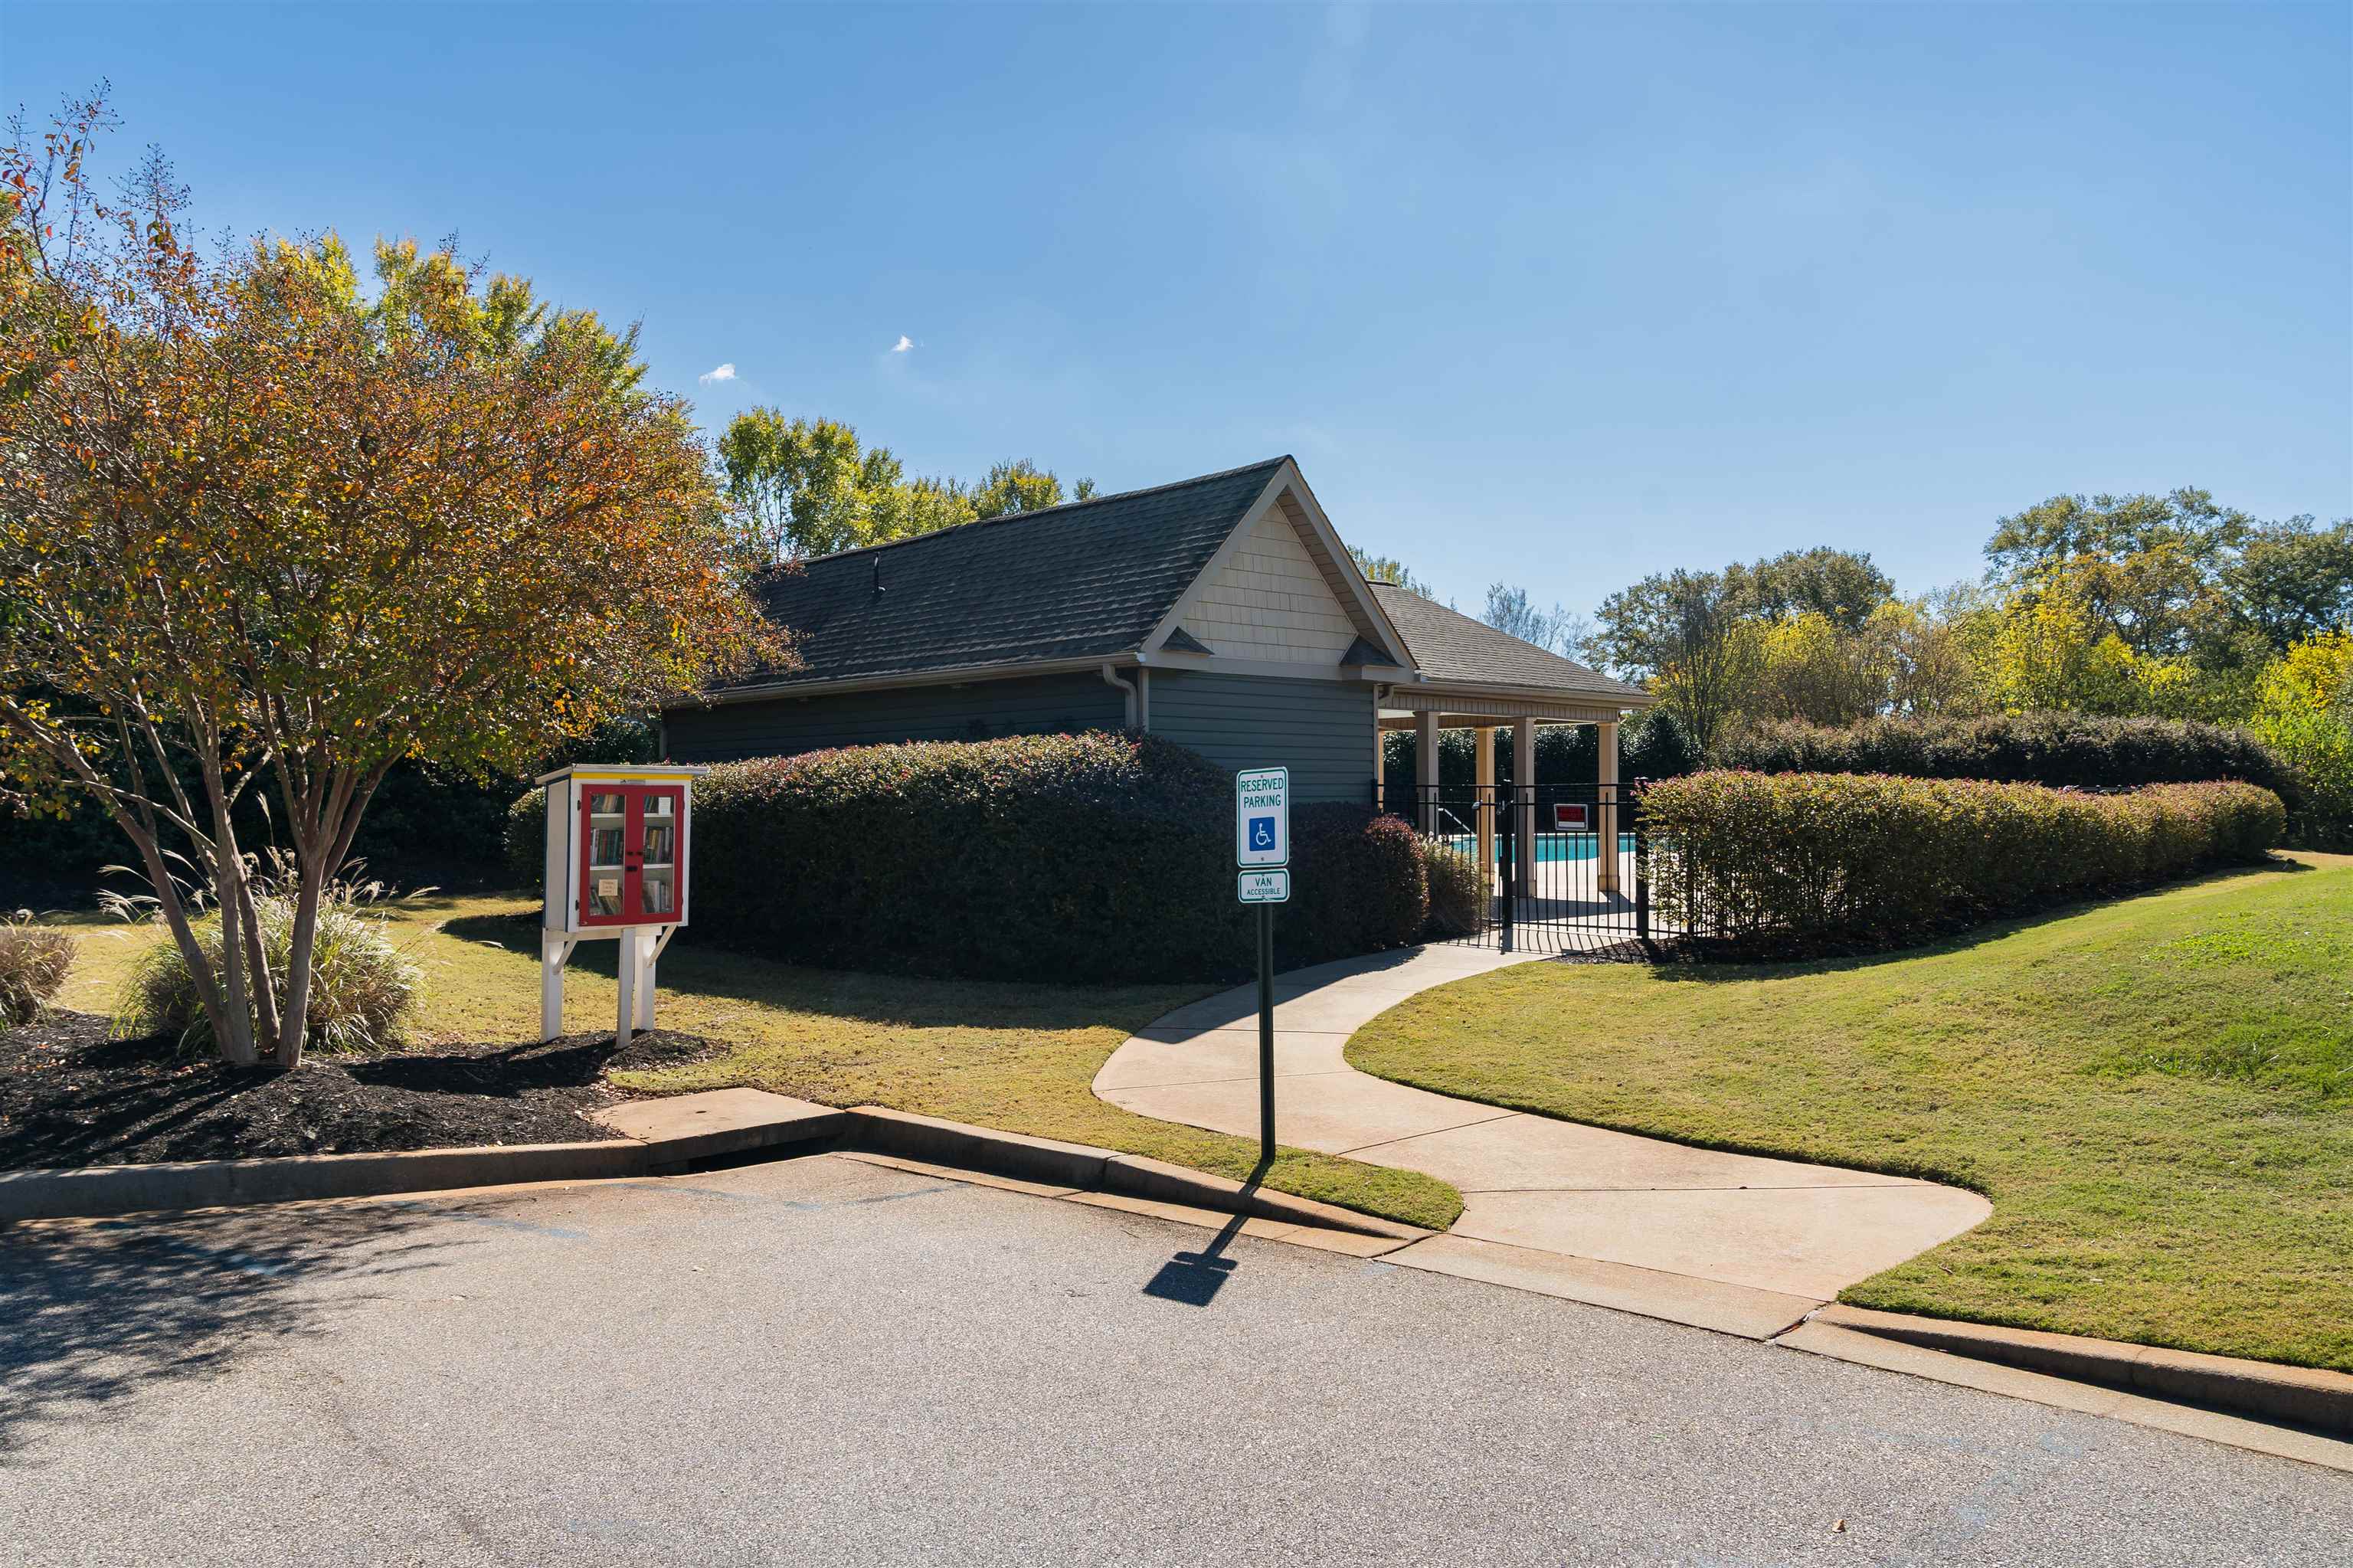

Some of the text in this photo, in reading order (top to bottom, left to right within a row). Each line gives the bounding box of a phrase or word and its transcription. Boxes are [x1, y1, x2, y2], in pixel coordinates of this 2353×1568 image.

[1241, 777, 1284, 792] RESERVED
[1244, 794, 1281, 809] PARKING
[1255, 876, 1272, 886] VAN
